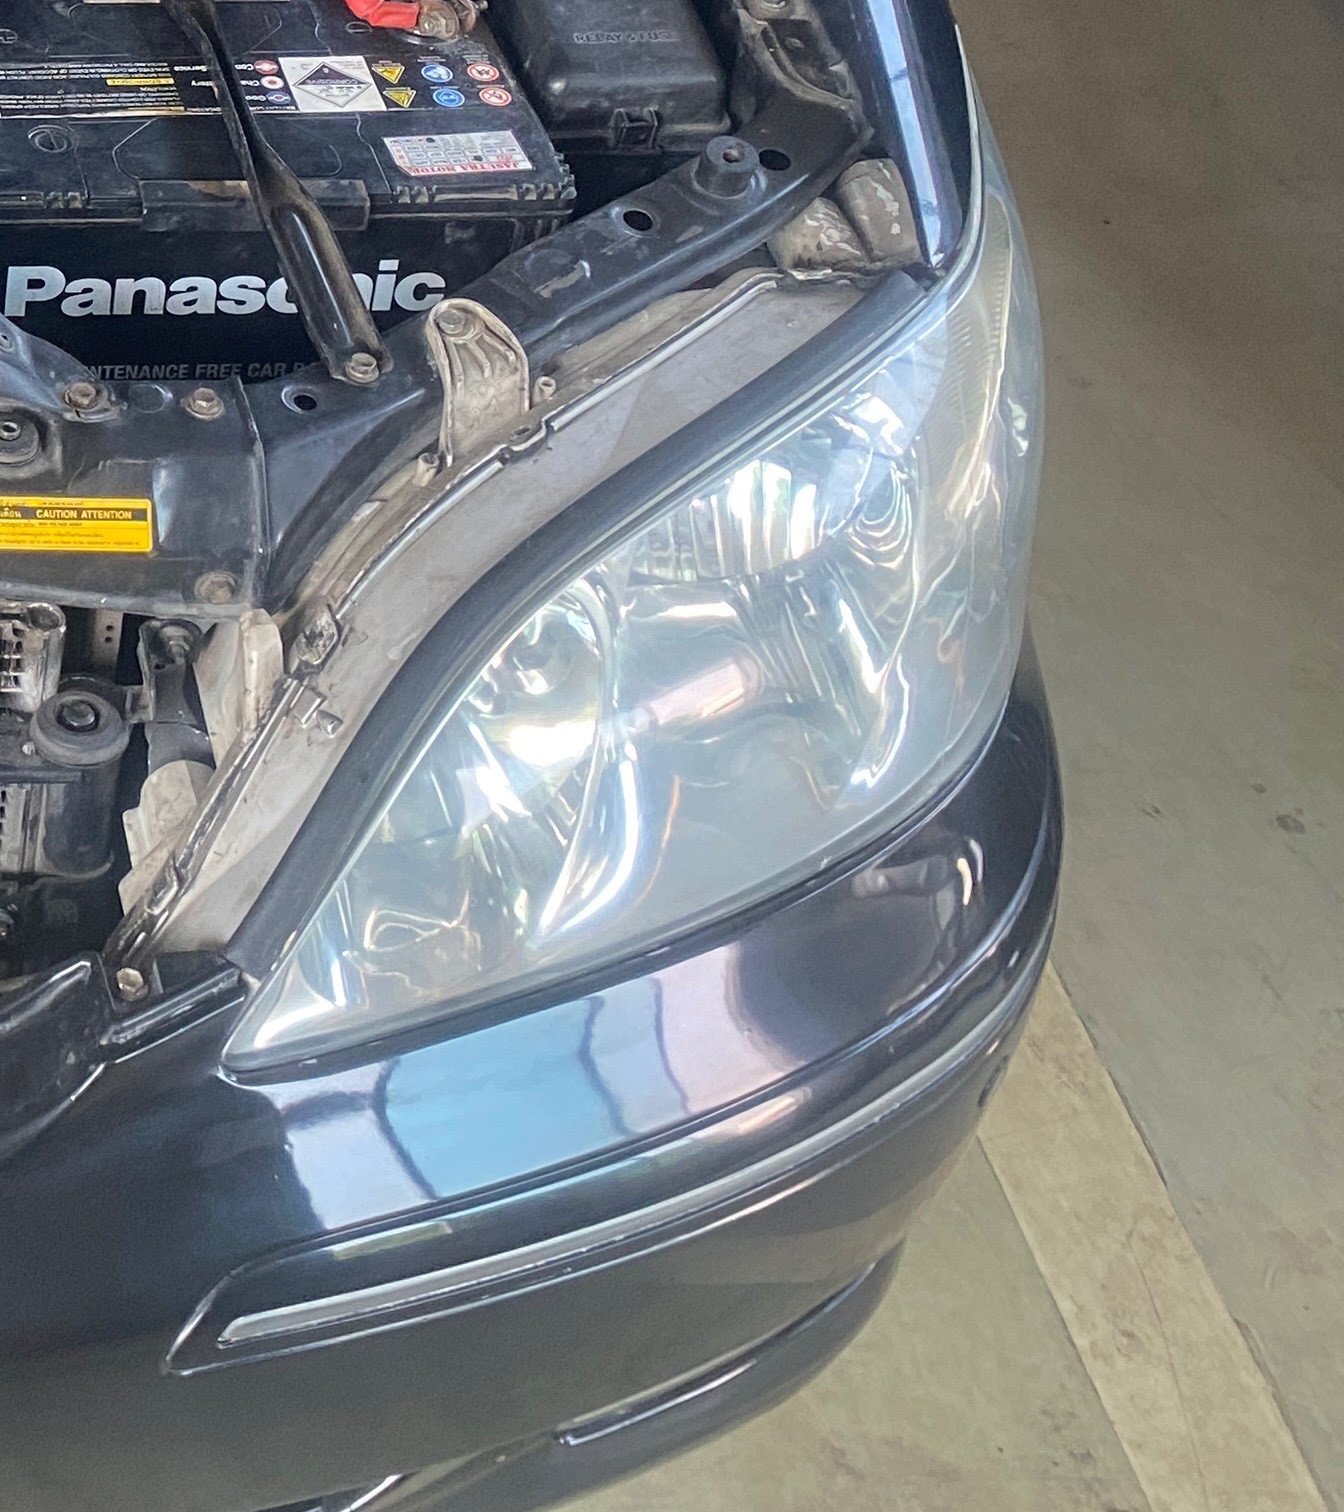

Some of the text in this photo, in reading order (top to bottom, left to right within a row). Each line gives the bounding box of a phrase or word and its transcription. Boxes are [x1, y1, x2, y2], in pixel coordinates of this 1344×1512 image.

[4, 259, 447, 318] Panasic
[87, 364, 189, 380] NTENANCE
[194, 363, 243, 379] FREE
[247, 362, 286, 378] CAR
[35, 508, 132, 520] CAUTION ATTENTION
